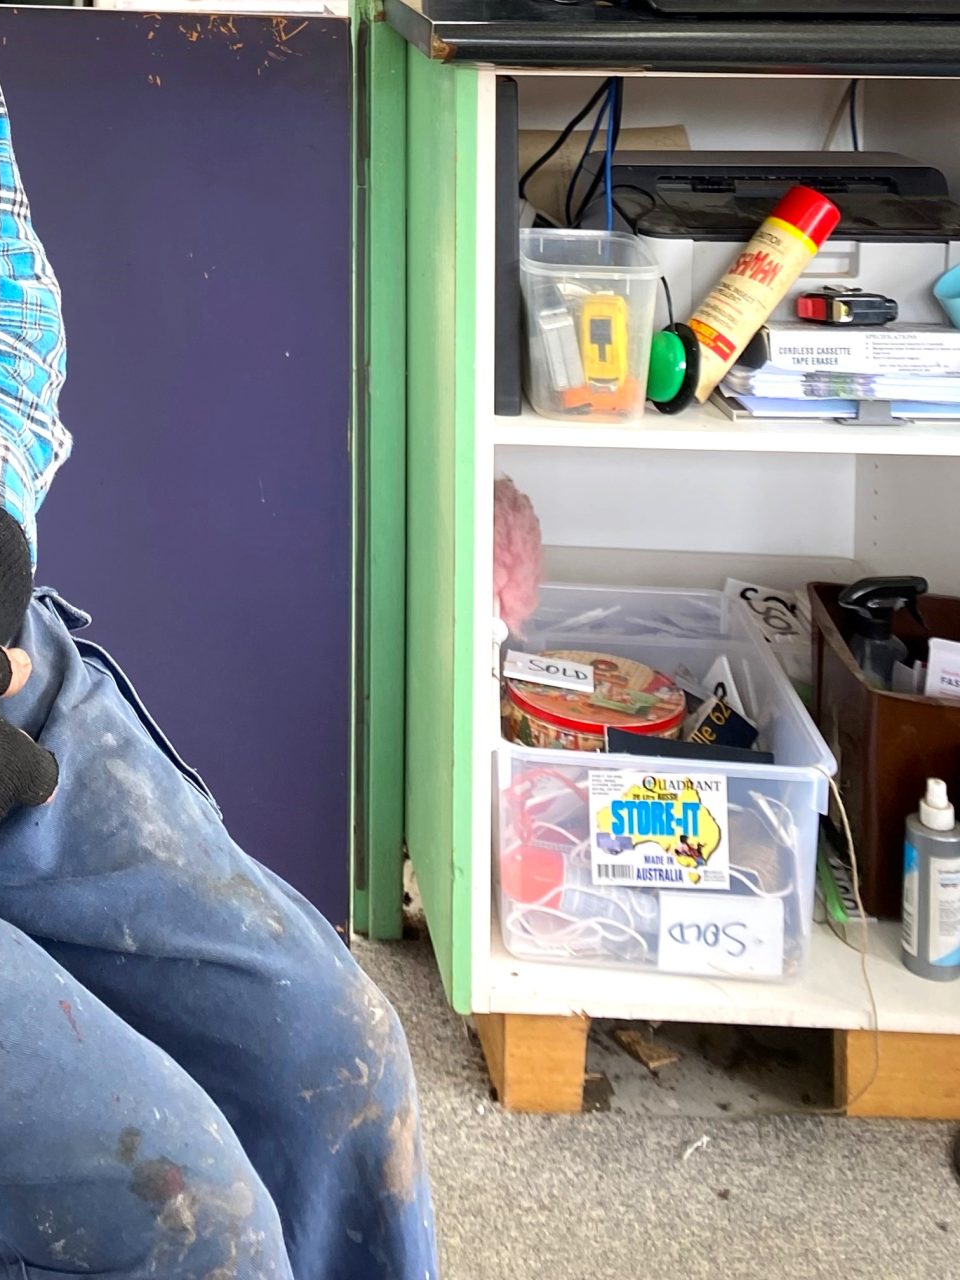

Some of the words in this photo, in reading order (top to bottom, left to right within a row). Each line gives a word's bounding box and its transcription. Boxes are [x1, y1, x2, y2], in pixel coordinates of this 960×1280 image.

[778, 346, 815, 356] CORDLESS
[817, 347, 851, 356] CASSETTE
[792, 357, 809, 366] TAPE
[811, 357, 839, 366] ERASER
[529, 658, 588, 681] SOLD
[715, 698, 732, 726] 62
[642, 774, 722, 795] QUADRANT
[611, 800, 701, 837] STORE-IT
[644, 855, 664, 865] MADE
[666, 856, 674, 865] IN
[636, 867, 684, 882] AUSTRALIA
